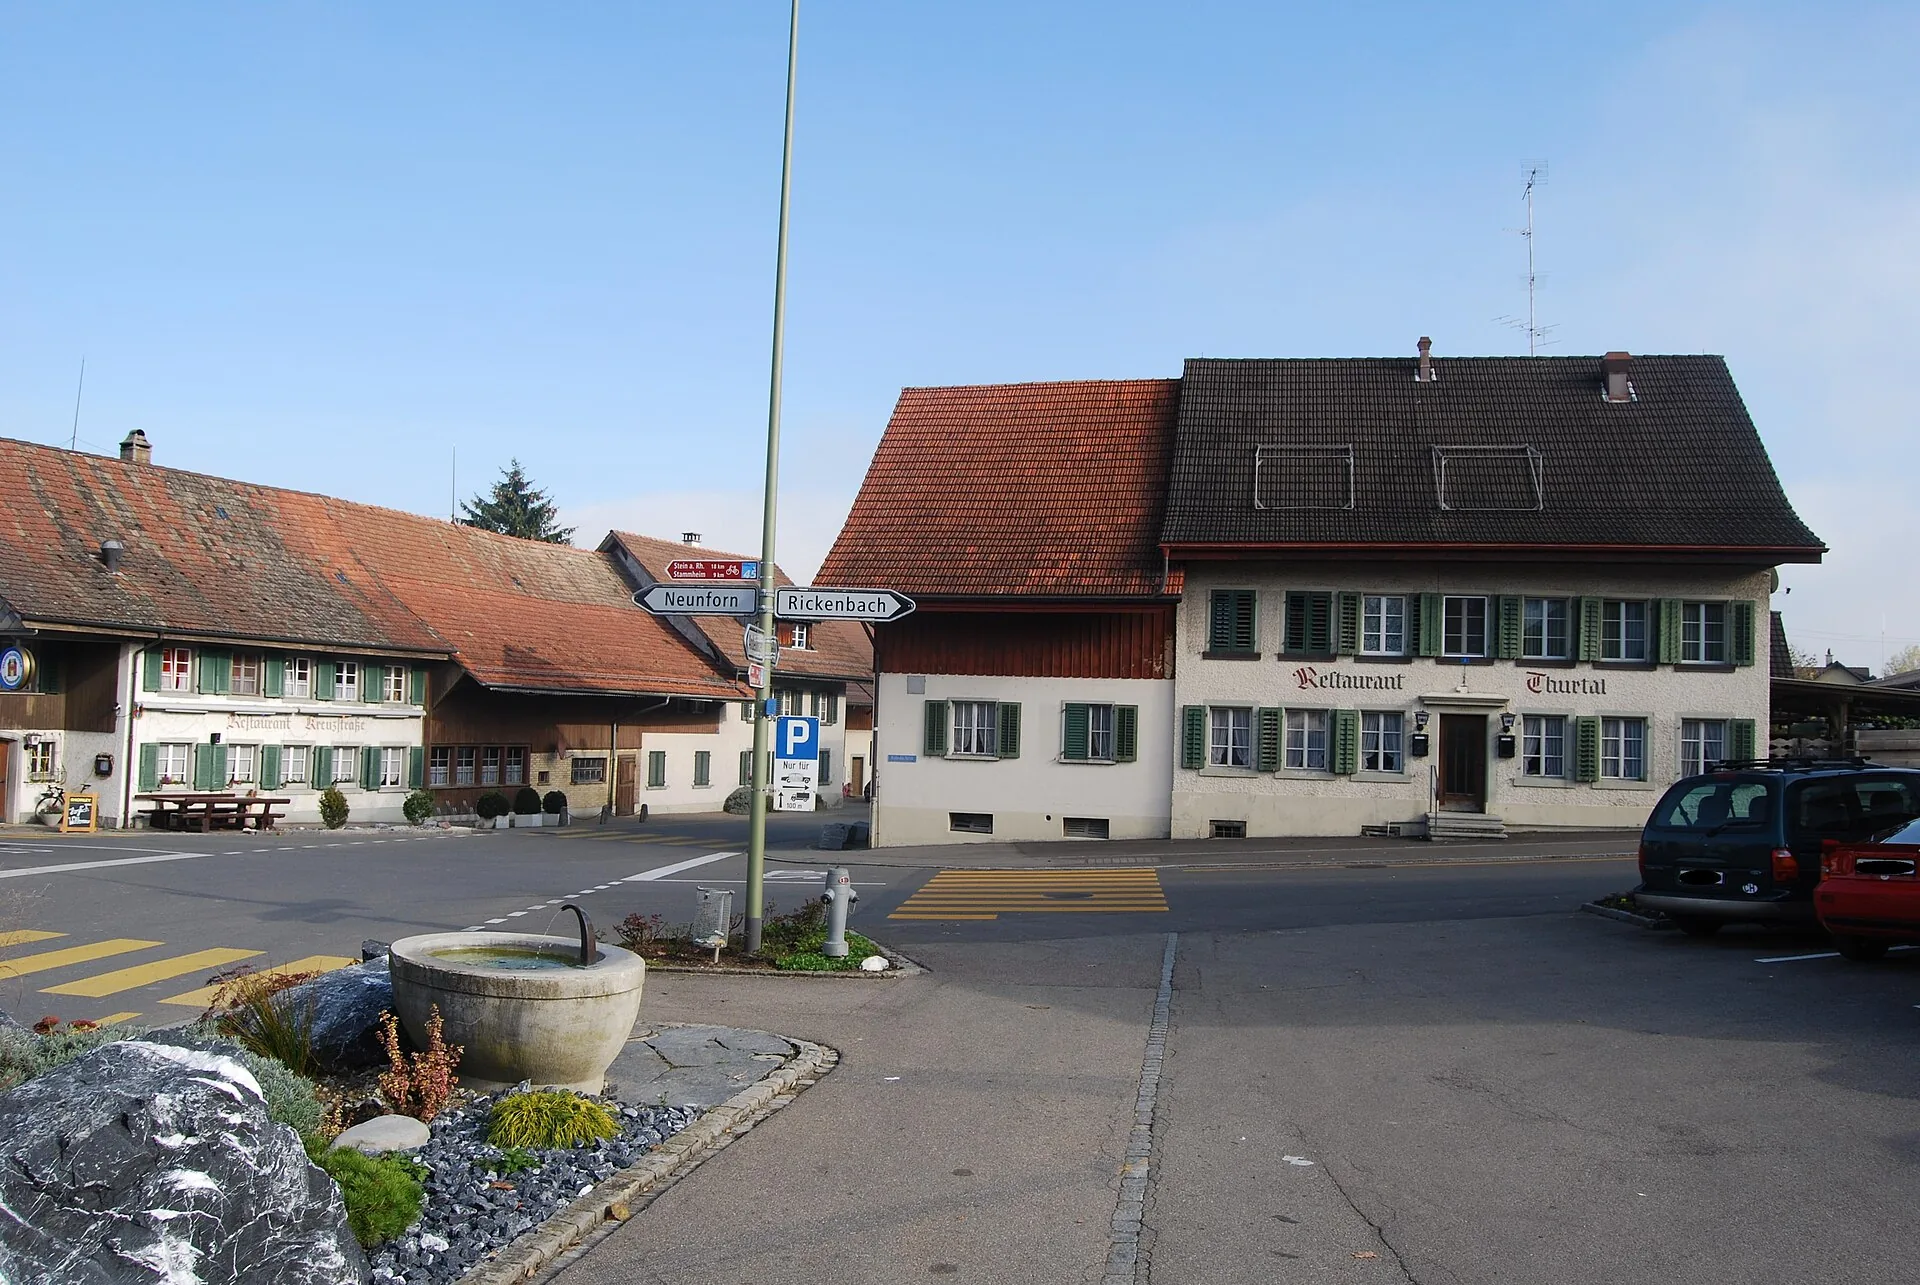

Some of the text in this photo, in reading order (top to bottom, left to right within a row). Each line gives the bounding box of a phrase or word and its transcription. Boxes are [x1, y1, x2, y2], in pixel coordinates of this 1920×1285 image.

[673, 562, 689, 570] Stein
[695, 562, 705, 570] Rh.
[664, 590, 739, 608] Neunforn
[788, 595, 887, 614] Rickenbach
[1292, 666, 1607, 695] Restaurant Thurtal
[226, 712, 291, 731] Restaurant
[786, 719, 810, 755] P
[783, 761, 810, 770] Nur für
